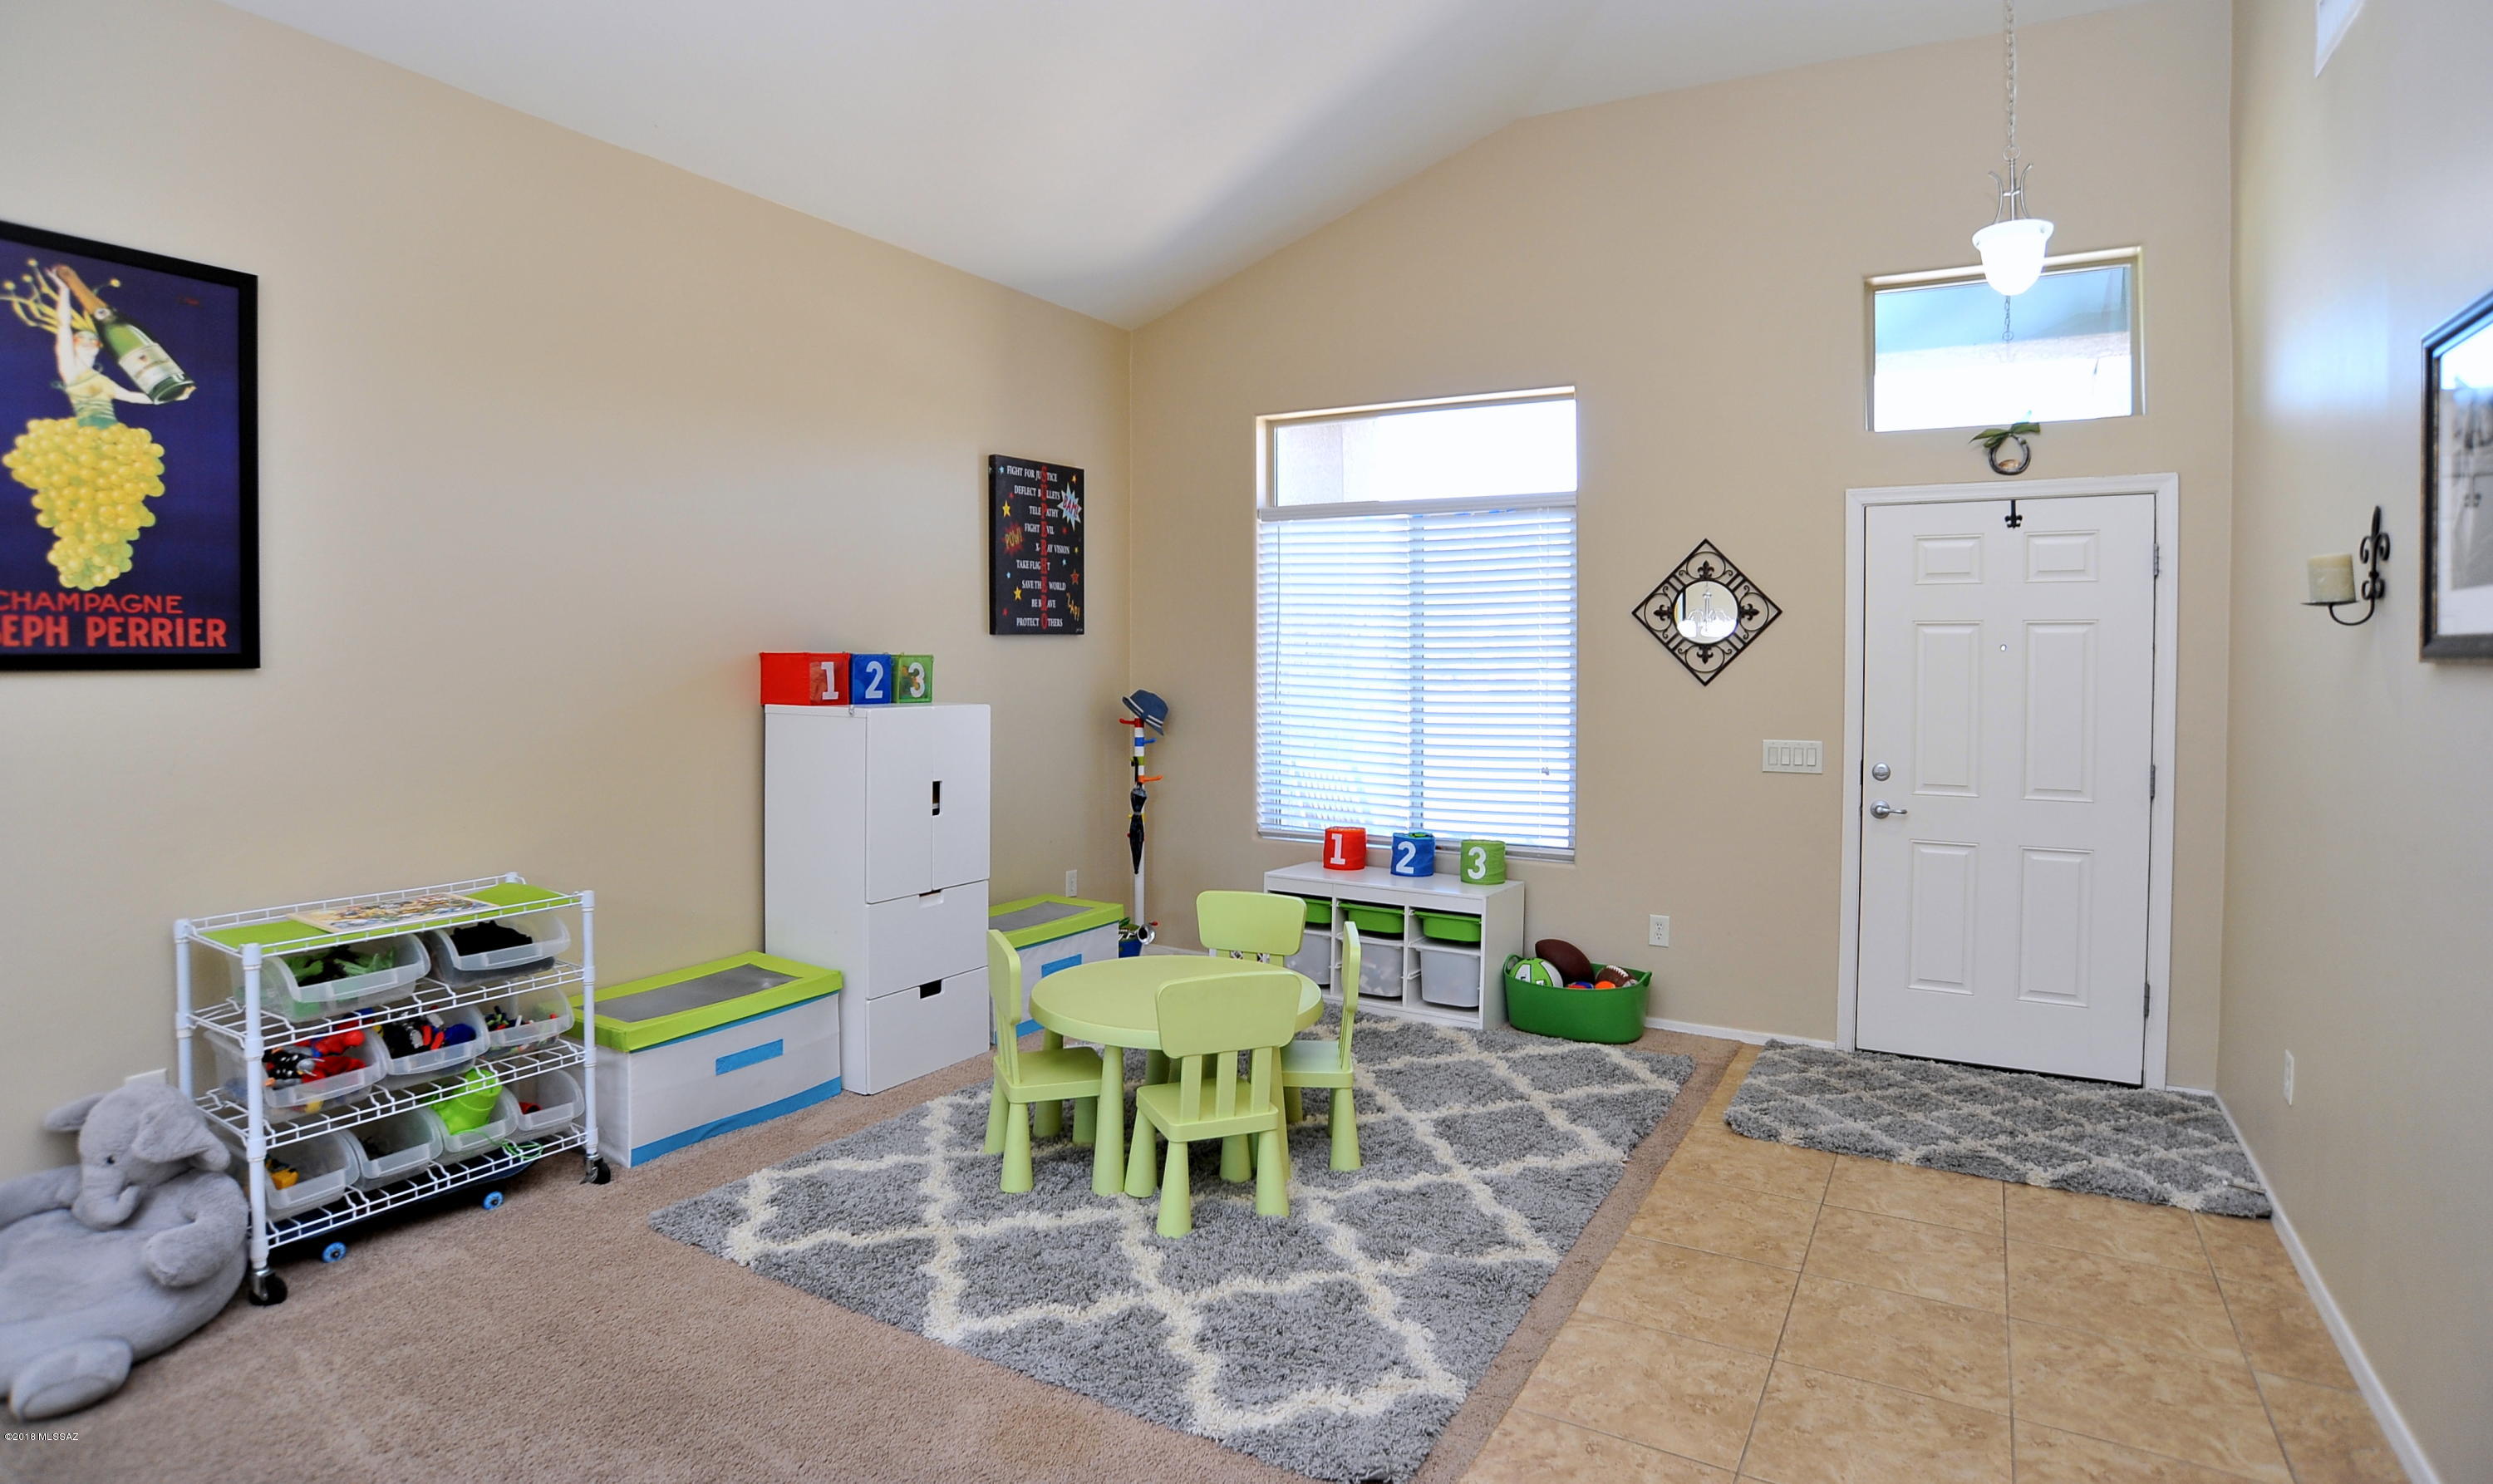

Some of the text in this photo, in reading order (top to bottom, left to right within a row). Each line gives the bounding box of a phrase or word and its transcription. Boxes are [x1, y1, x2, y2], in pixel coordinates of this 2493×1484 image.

[1006, 465, 1023, 476] FIGHT
[1024, 469, 1035, 479] FOR
[1014, 484, 1036, 496] DEFLECT
[1025, 523, 1040, 533] FIGHT
[1054, 545, 1069, 554] VISION
[1016, 559, 1029, 569] TAKE
[1022, 579, 1035, 589] SAVE
[1049, 582, 1066, 591] WORLD
[1031, 599, 1038, 607] BE
[1016, 617, 1040, 627] PROTECT
[0, 615, 227, 647] EPH PERRIER
[821, 661, 838, 700] 1
[865, 661, 883, 699] 2
[908, 662, 925, 698] 3
[1330, 833, 1346, 865] 1
[1395, 841, 1416, 873] 2
[1468, 847, 1487, 879] 3
